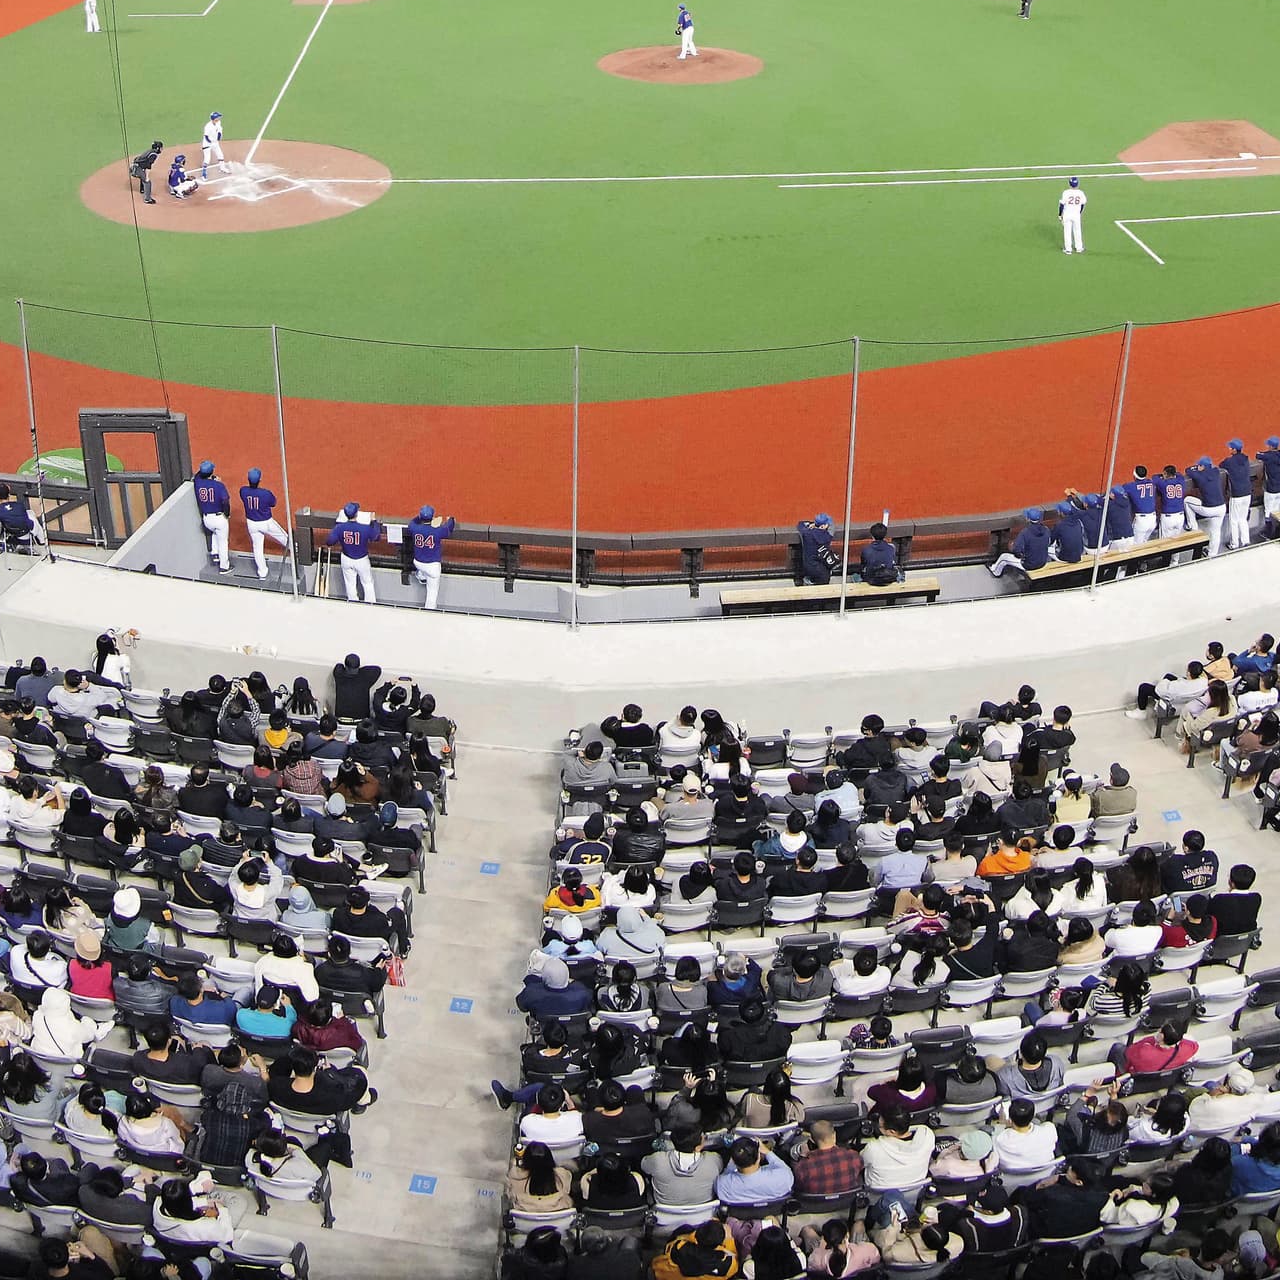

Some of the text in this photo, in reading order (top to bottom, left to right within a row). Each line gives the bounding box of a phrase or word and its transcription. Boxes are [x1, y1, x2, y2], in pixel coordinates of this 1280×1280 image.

[199, 487, 214, 502] 81
[1137, 484, 1153, 497] 77
[247, 496, 259, 510] 11
[344, 530, 360, 545] 51
[414, 533, 434, 549] 84
[581, 854, 602, 865] 32
[455, 1000, 468, 1010] 12
[417, 1179, 431, 1190] 15
